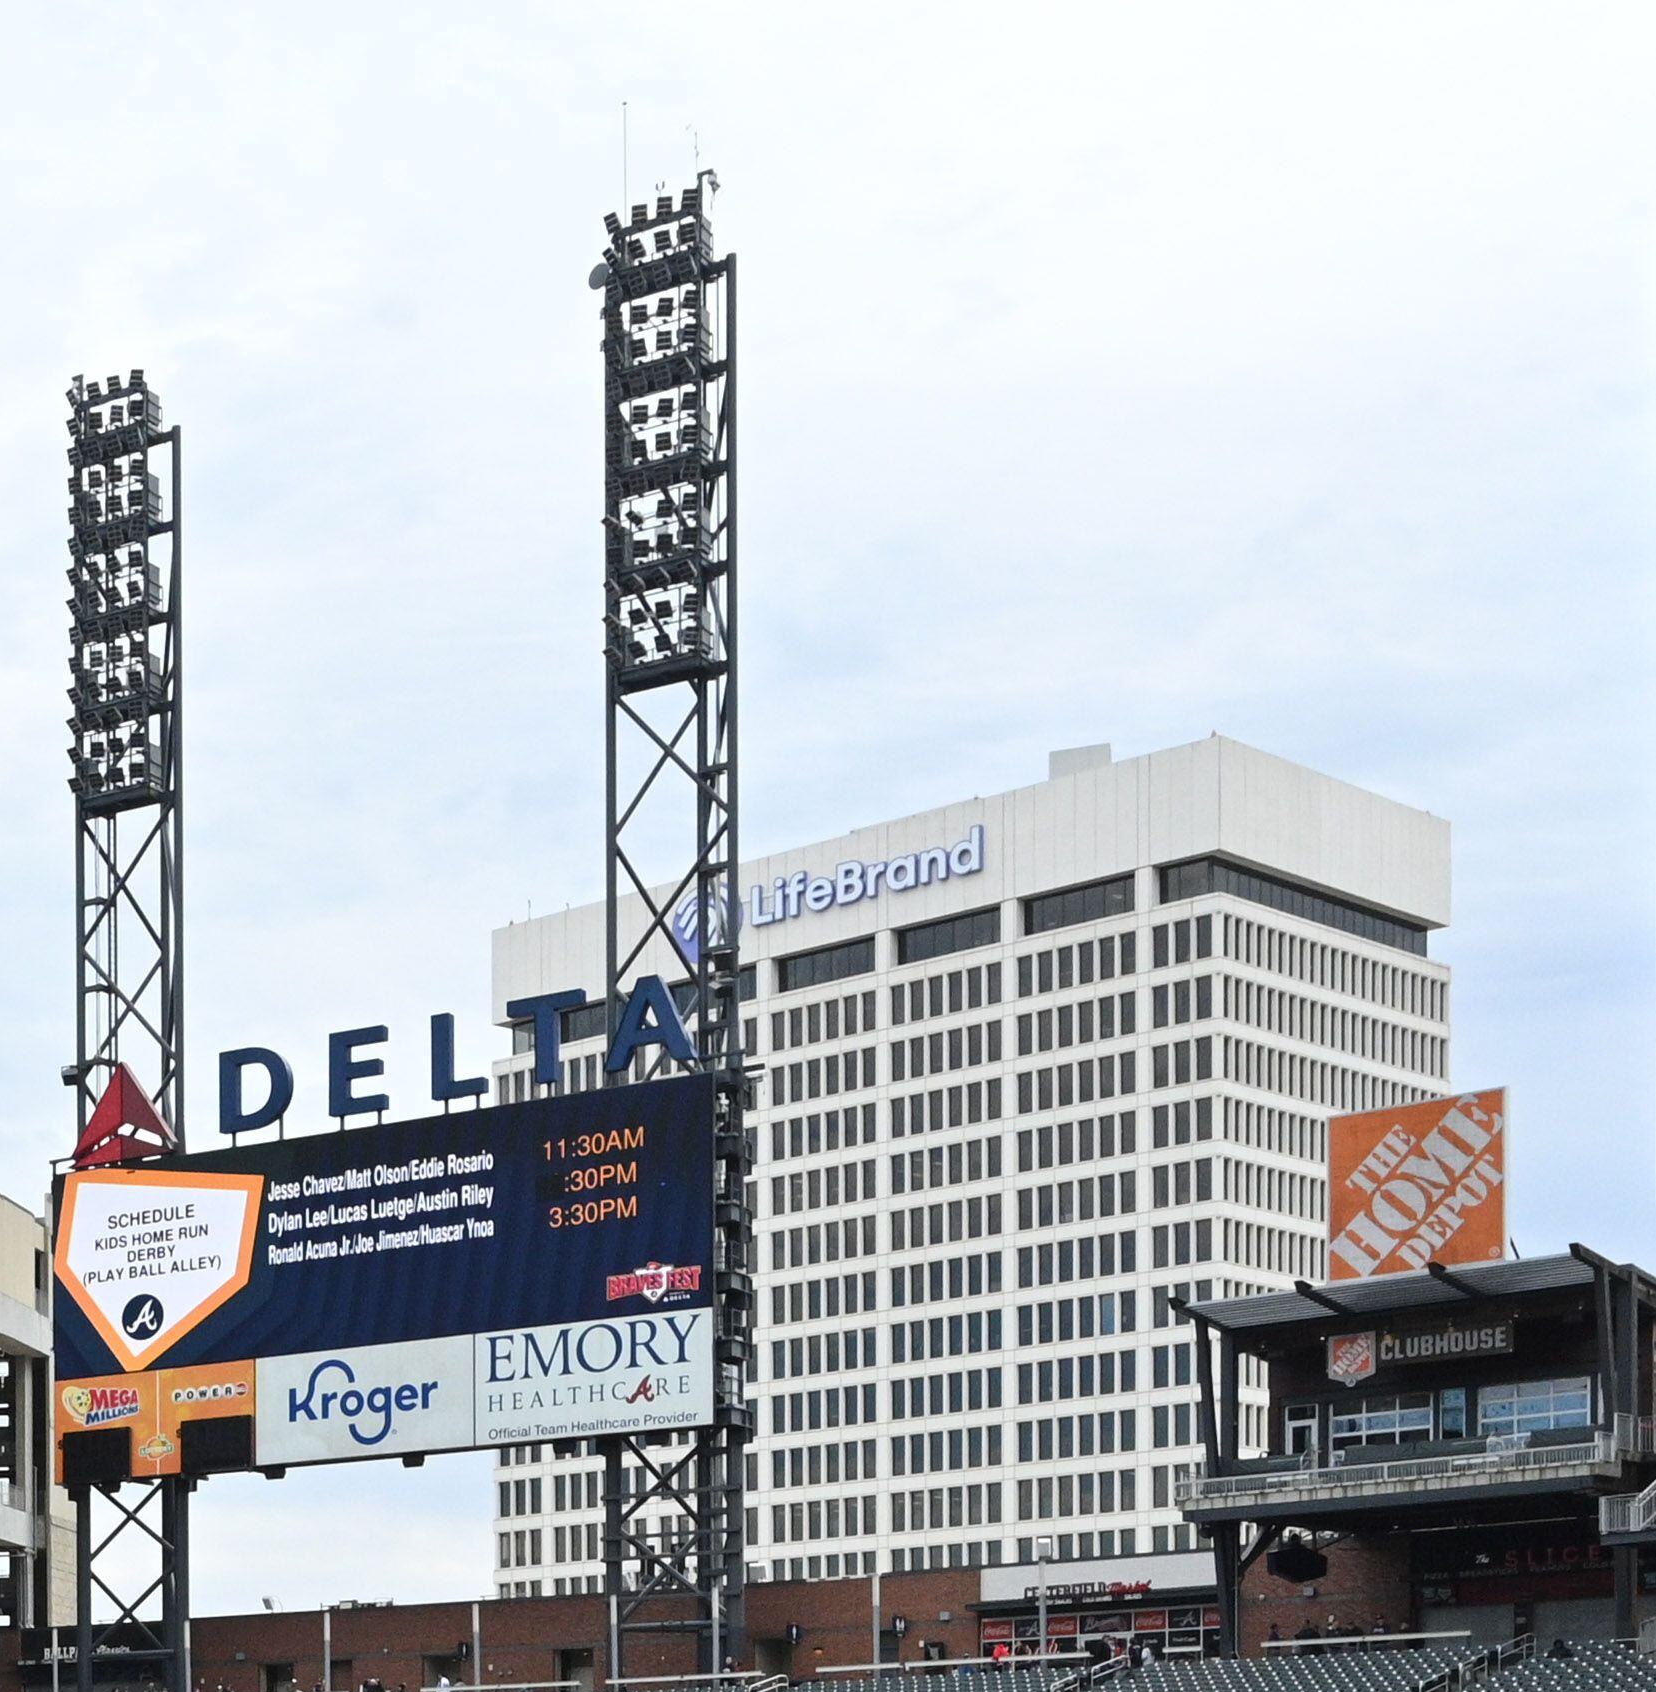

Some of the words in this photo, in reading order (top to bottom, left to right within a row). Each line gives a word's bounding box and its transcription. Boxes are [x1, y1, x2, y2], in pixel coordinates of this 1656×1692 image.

[750, 825, 985, 926] LifeBrand
[219, 975, 699, 1134] DELTA
[543, 1126, 645, 1161] 11:30AM
[1345, 1123, 1418, 1196] THE
[267, 1180, 300, 1202] Jesse
[303, 1168, 372, 1197] Chavez/Matt
[374, 1156, 445, 1186] Olson/Eddie
[447, 1149, 494, 1175] Rosario
[563, 1161, 637, 1192] :30PM
[1329, 1093, 1504, 1277] HOME
[107, 1204, 195, 1229] SCHEDULE
[268, 1211, 303, 1238] Dylan
[305, 1204, 368, 1228] Lee/Lucas
[371, 1189, 458, 1220] Luetge/Austin
[461, 1184, 494, 1208] Riley
[549, 1195, 637, 1229] 3:30PM
[1395, 1153, 1504, 1270] DEPOT
[94, 1235, 128, 1251] KIDS
[131, 1229, 174, 1246] HOME
[178, 1224, 209, 1240] RUN
[127, 1245, 176, 1263] DERBY
[268, 1241, 303, 1266] Ronald
[305, 1238, 338, 1260] Acuna
[376, 1223, 464, 1251] Jimenez/Huascar
[467, 1217, 494, 1239] Ynoa
[82, 1267, 124, 1287] (PLAY
[129, 1259, 166, 1278] BALL
[170, 1254, 222, 1273] ALLEY)
[606, 1273, 665, 1300] BRAVES
[666, 1265, 702, 1291] FEST
[485, 1313, 701, 1383] EMORY
[1380, 1326, 1507, 1361] CLUBHOUSE
[88, 1387, 138, 1409] MEGA
[173, 1386, 233, 1402] POWER
[288, 1359, 439, 1446] Kroger
[489, 1374, 691, 1413] HEALTHCARE
[85, 1405, 139, 1426] MILLIONS
[488, 1426, 531, 1441] Official
[534, 1423, 569, 1436] Team
[571, 1416, 640, 1433] Healthcare
[643, 1410, 698, 1427] Provider
[1505, 1545, 1601, 1569] SLICE
[1024, 1582, 1106, 1599] CETERFIELD
